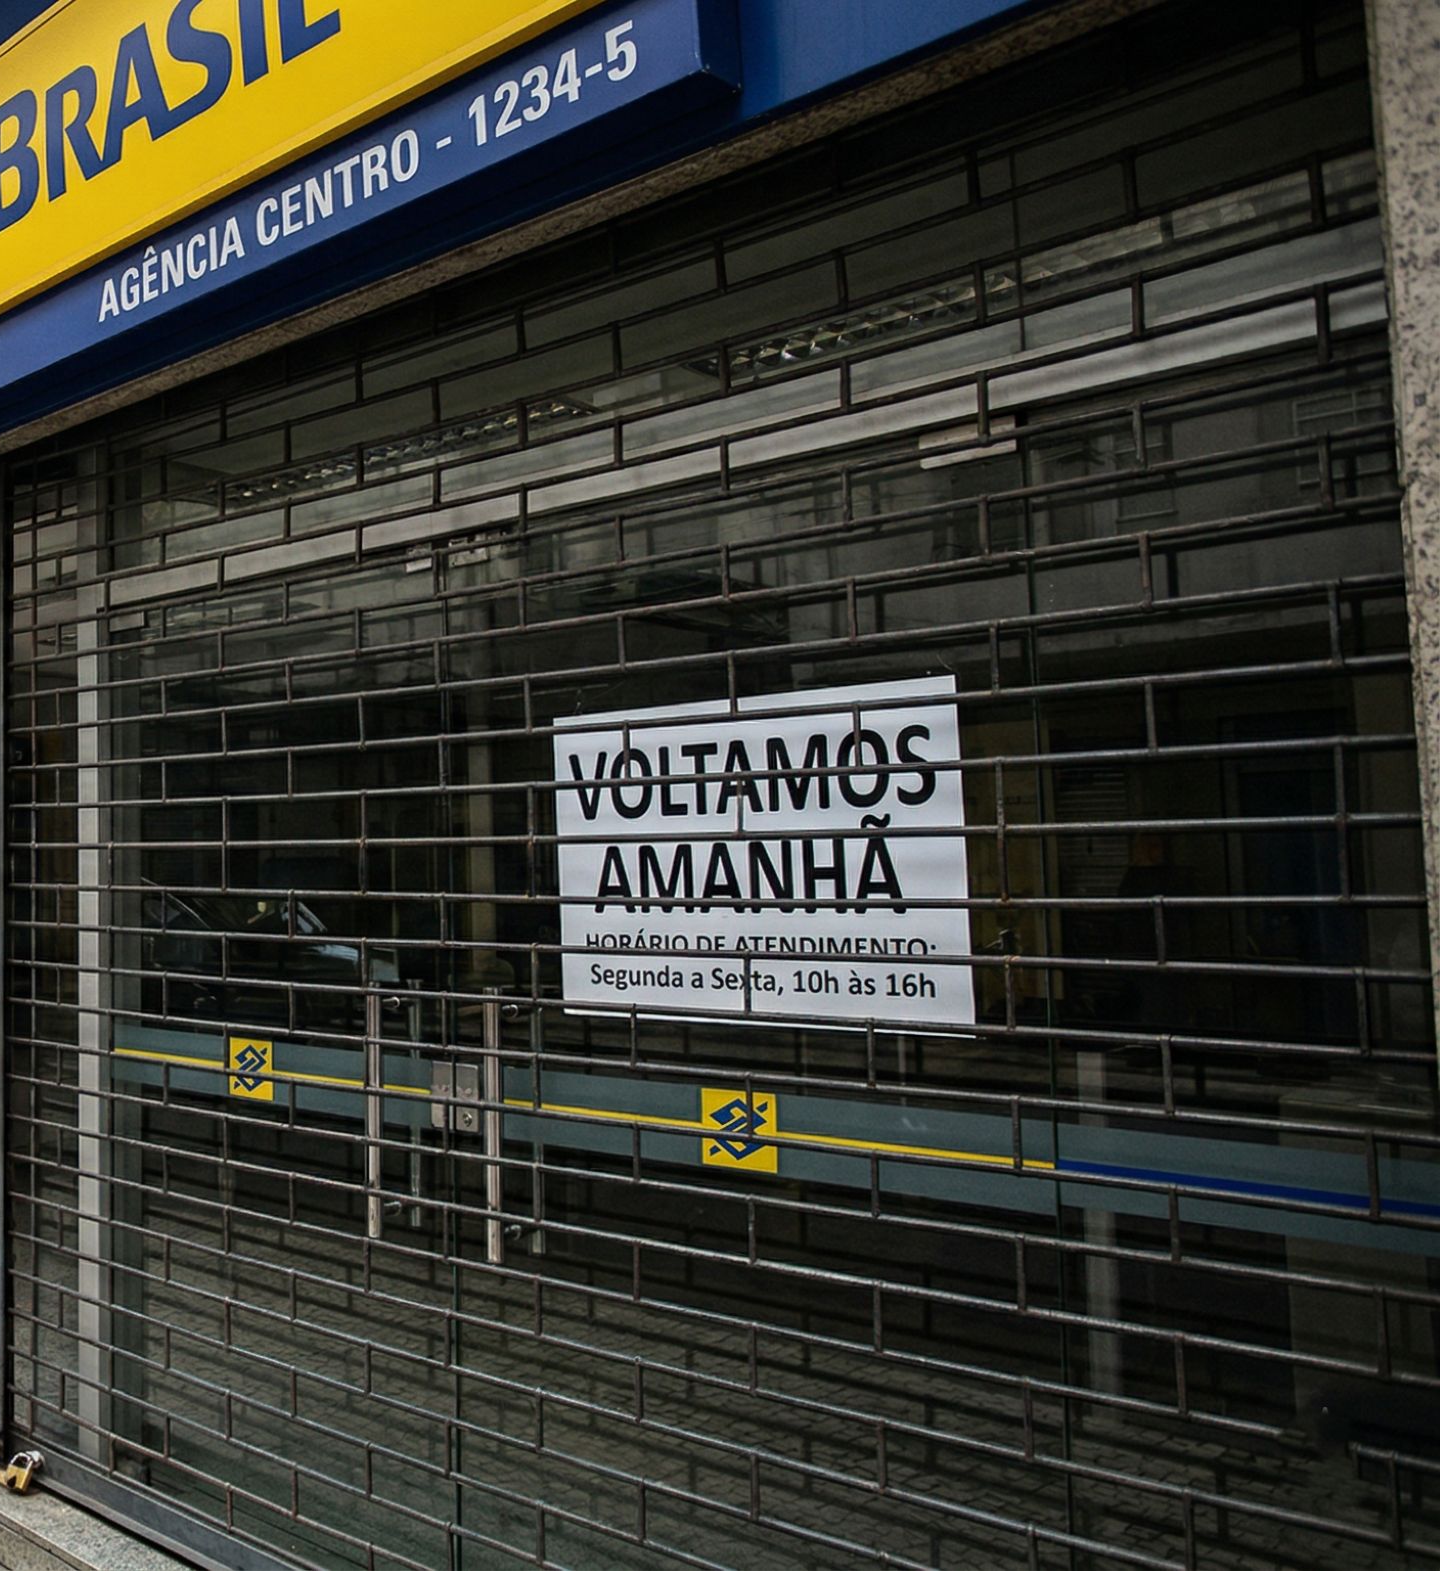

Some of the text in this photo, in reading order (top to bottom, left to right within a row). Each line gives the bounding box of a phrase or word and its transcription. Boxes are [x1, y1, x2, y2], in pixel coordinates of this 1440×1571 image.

[98, 20, 638, 322] AGÊNCIA CENTRO - 1234-5
[569, 725, 937, 820] VOLTAMOS
[595, 814, 907, 914] AMANHÃ
[586, 928, 689, 951] HORÁRIO
[696, 936, 726, 951] DE
[591, 963, 684, 990] Segunda
[691, 972, 704, 988] a
[792, 970, 839, 994] 10h
[848, 970, 876, 995] às
[886, 973, 937, 998] 16h
